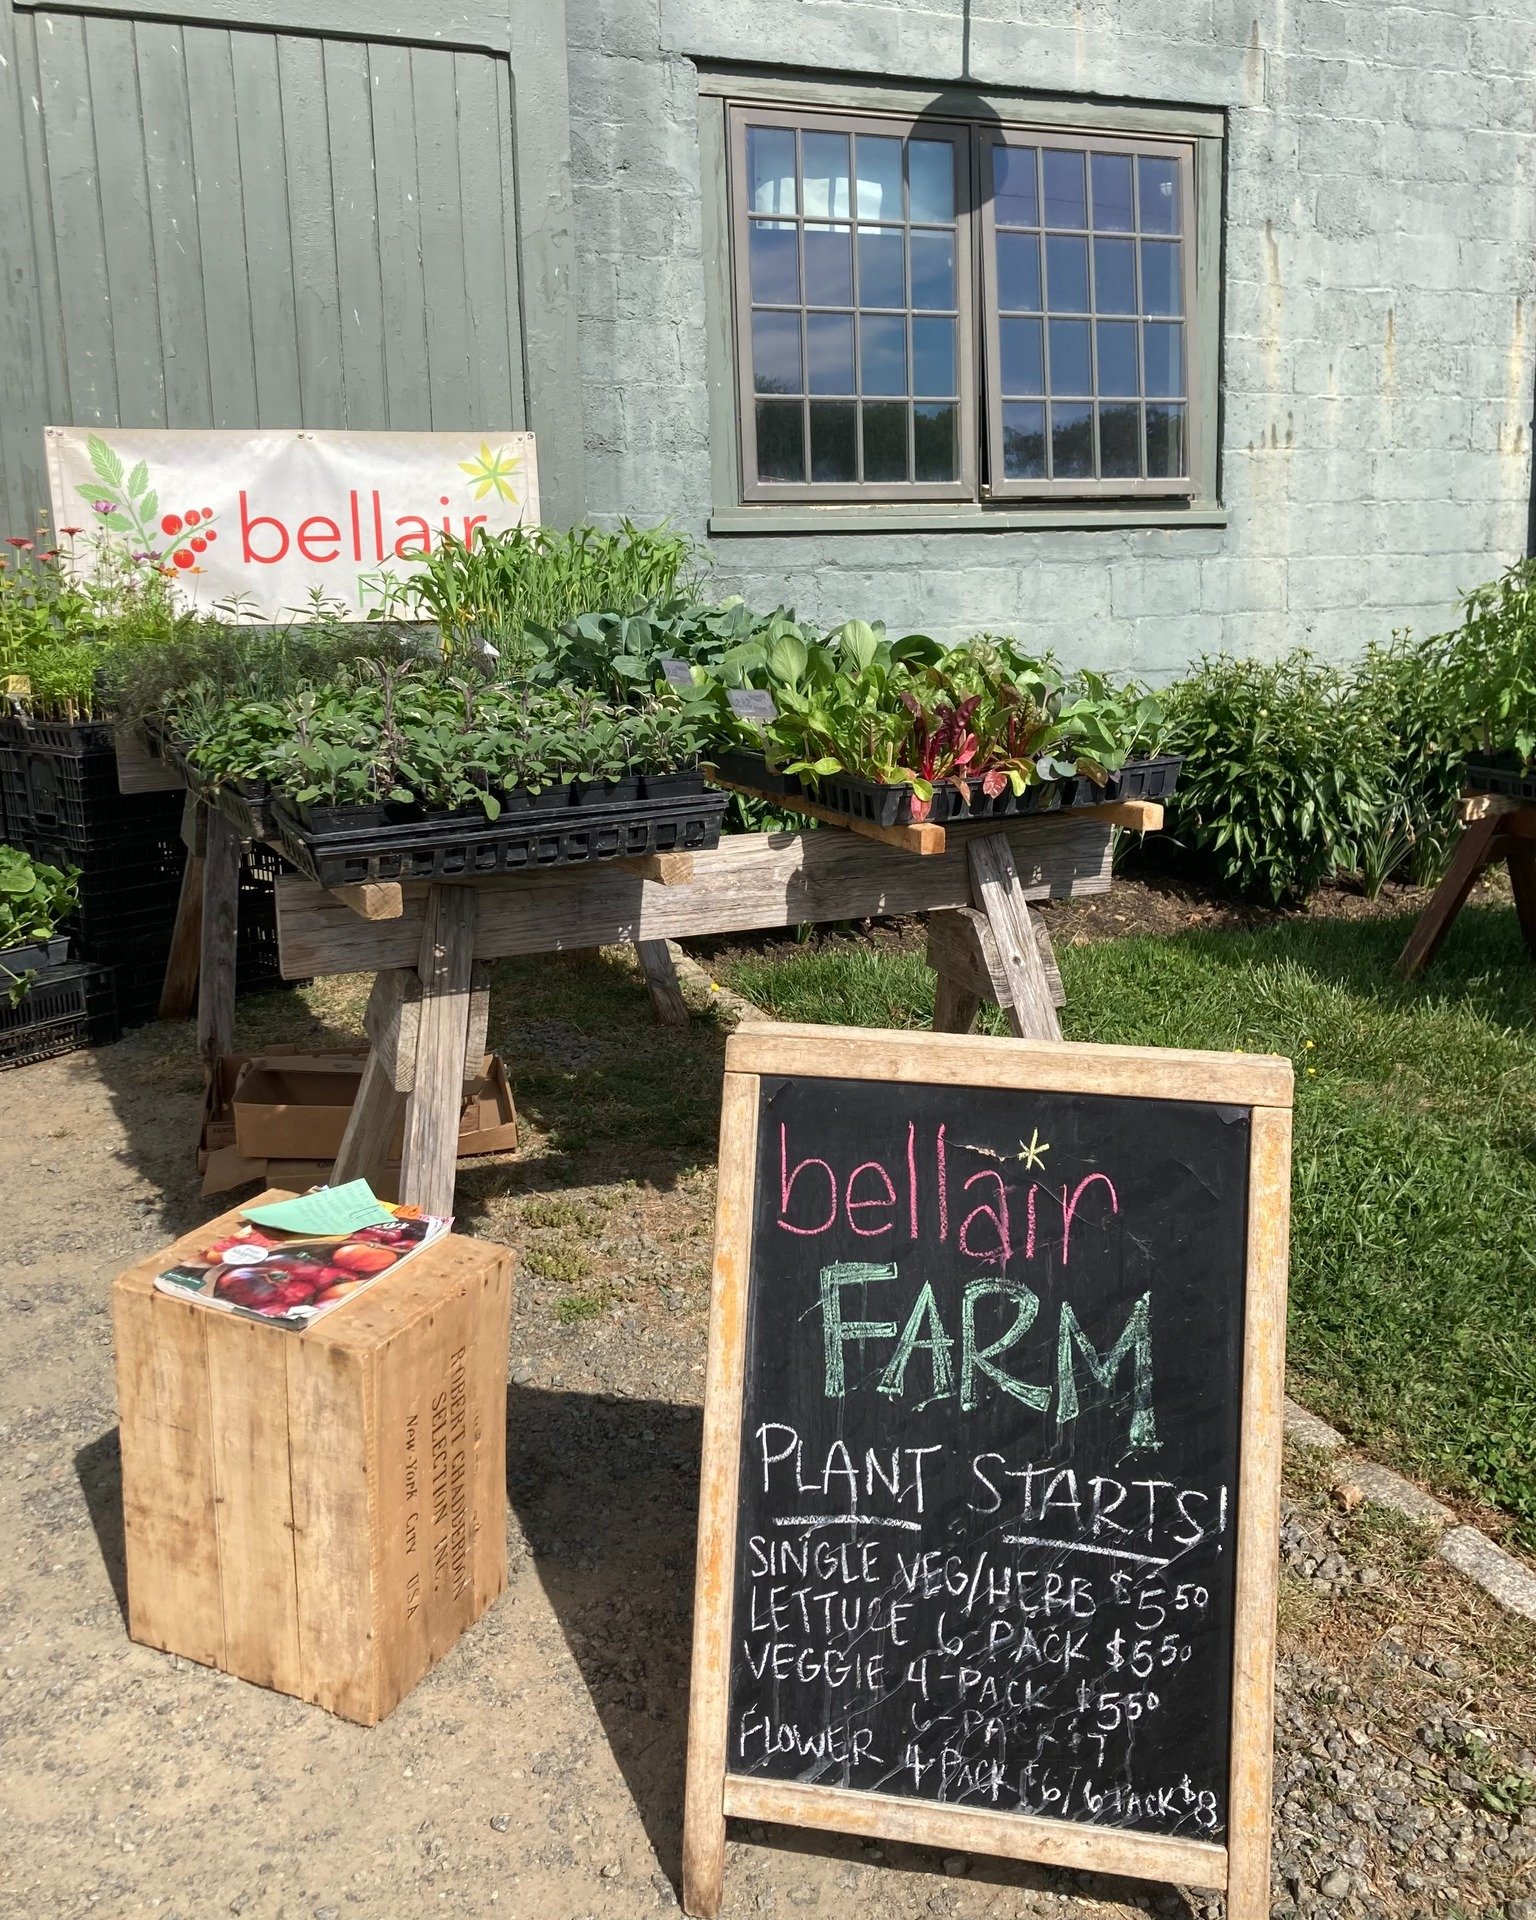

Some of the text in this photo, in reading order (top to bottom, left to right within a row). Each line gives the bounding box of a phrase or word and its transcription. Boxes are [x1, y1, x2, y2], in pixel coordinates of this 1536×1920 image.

[239, 490, 487, 564] bellair
[777, 1121, 1118, 1266] bellair
[820, 1259, 1163, 1450] FARM
[431, 1392, 449, 1593] SELECTION INC.
[450, 1345, 467, 1602] ROBERT CHADDERDON
[756, 1422, 1227, 1551] PLANT STARTS!
[406, 1571, 420, 1620] USA
[749, 1536, 881, 1584] SINGLE
[744, 1640, 885, 1690] VEGGIE
[751, 1585, 915, 1646] LETTUCE
[988, 1620, 1091, 1674] PACK
[740, 1703, 885, 1766] FLOWER
